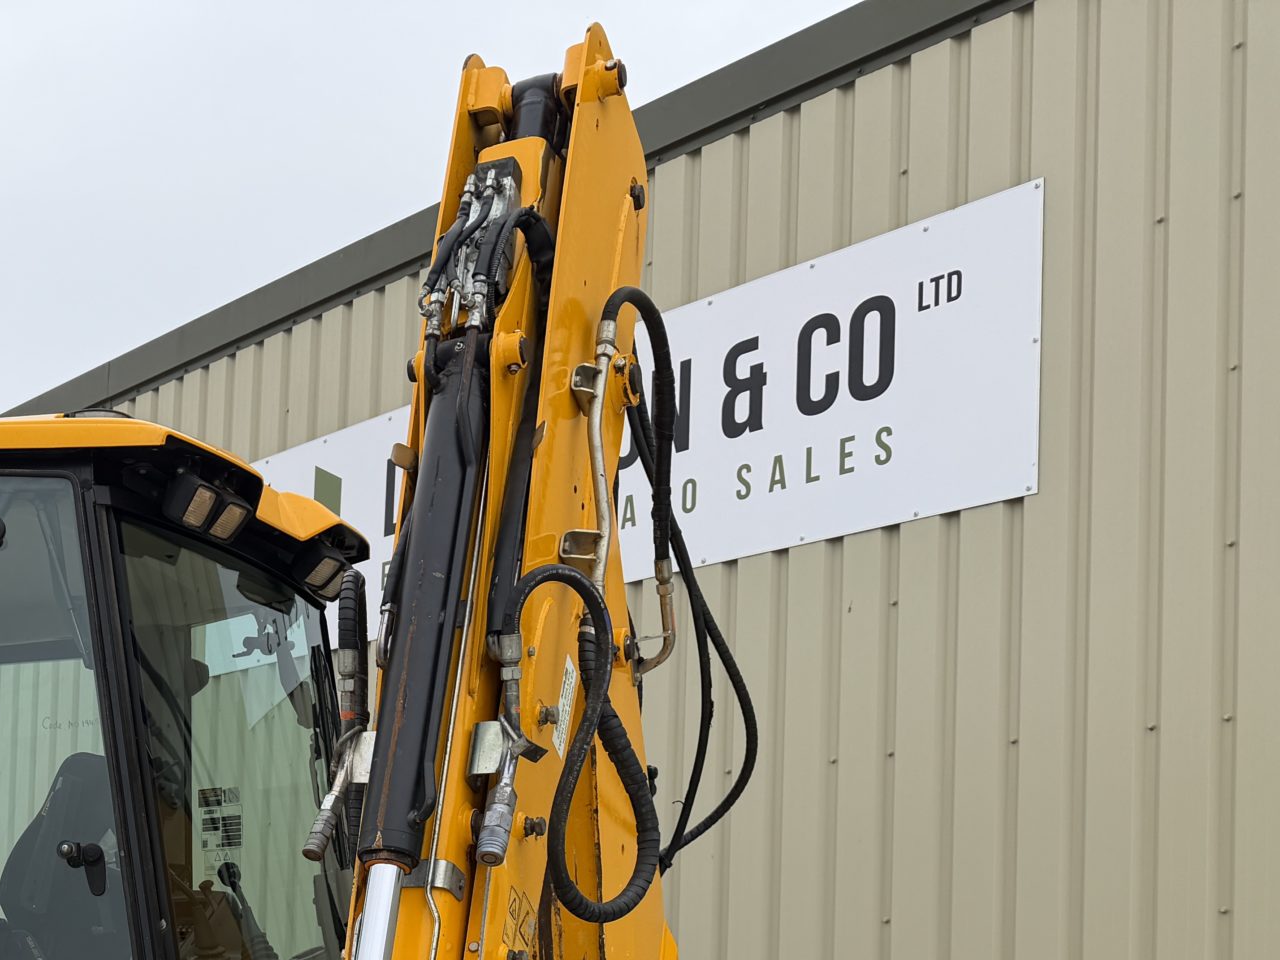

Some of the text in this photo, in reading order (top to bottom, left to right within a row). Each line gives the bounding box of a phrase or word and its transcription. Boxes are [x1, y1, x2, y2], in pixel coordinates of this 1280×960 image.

[722, 336, 768, 439] &
[796, 295, 896, 417] CO
[918, 270, 963, 313] LTD
[736, 427, 893, 501] SALES
